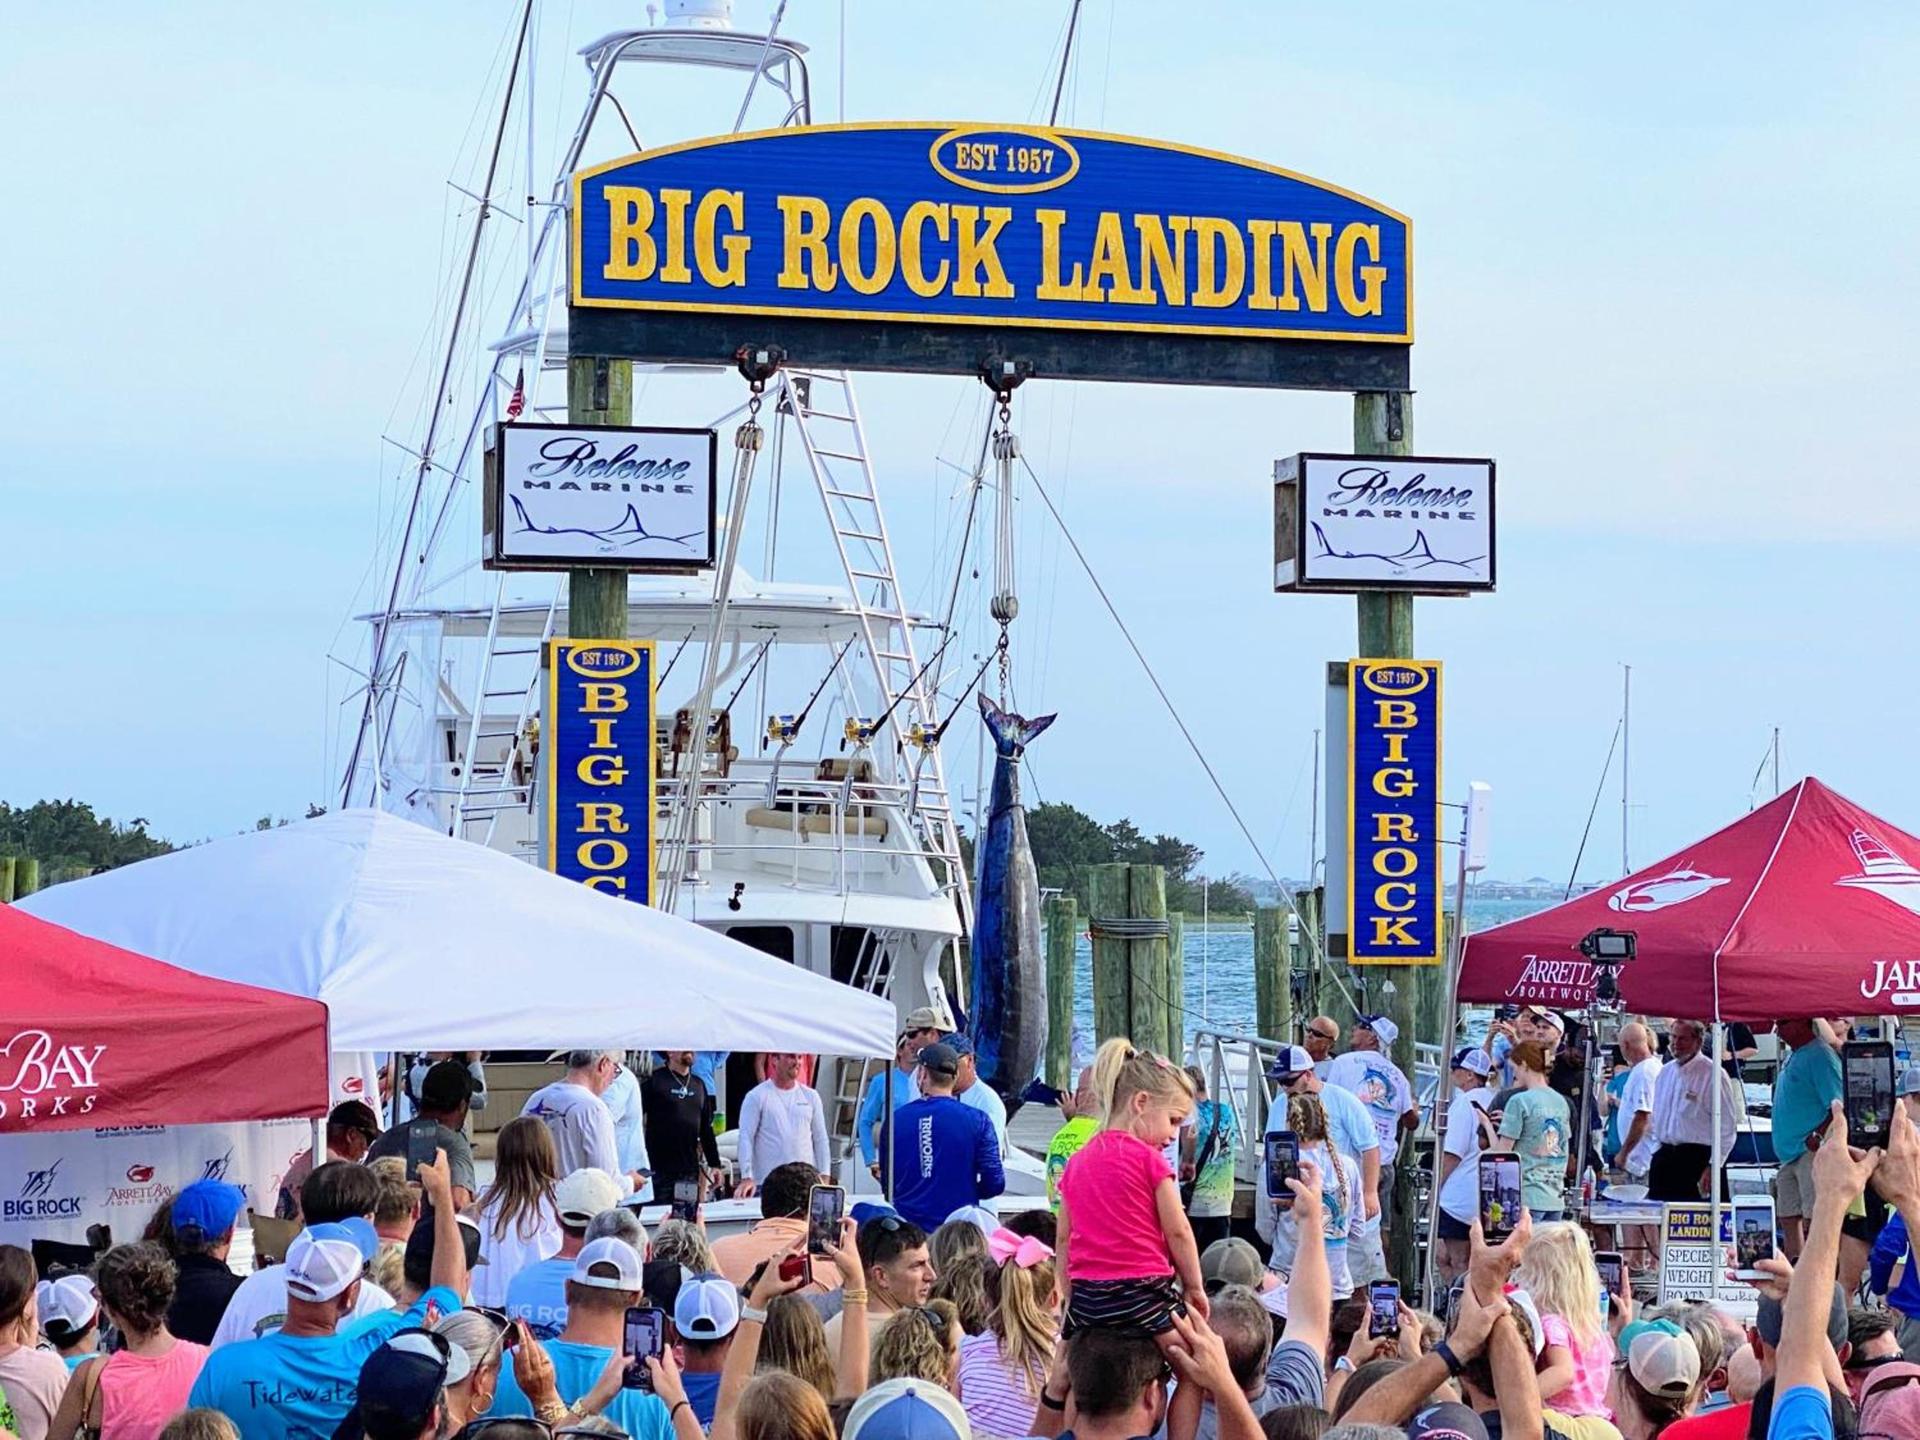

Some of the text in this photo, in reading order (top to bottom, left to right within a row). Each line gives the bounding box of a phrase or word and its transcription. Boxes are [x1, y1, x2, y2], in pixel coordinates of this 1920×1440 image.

[955, 142, 1054, 174] EST 1957
[603, 185, 1387, 317] BIG ROCK LANDING
[528, 437, 691, 480] Release
[524, 480, 694, 494] MARINE
[1327, 467, 1473, 507] Release
[1323, 508, 1476, 520] MARINE
[582, 652, 601, 666] EST
[1377, 671, 1394, 684] EST
[577, 683, 629, 786] BIG
[1372, 700, 1419, 797] BIG
[1370, 813, 1421, 945] ROCK
[1505, 955, 1592, 997] JARRETT
[4, 1197, 81, 1216] BIG ROCK
[1670, 1213, 1690, 1225] BIG
[1669, 1226, 1711, 1238] LANDIN
[242, 1380, 358, 1409] Tidewate
